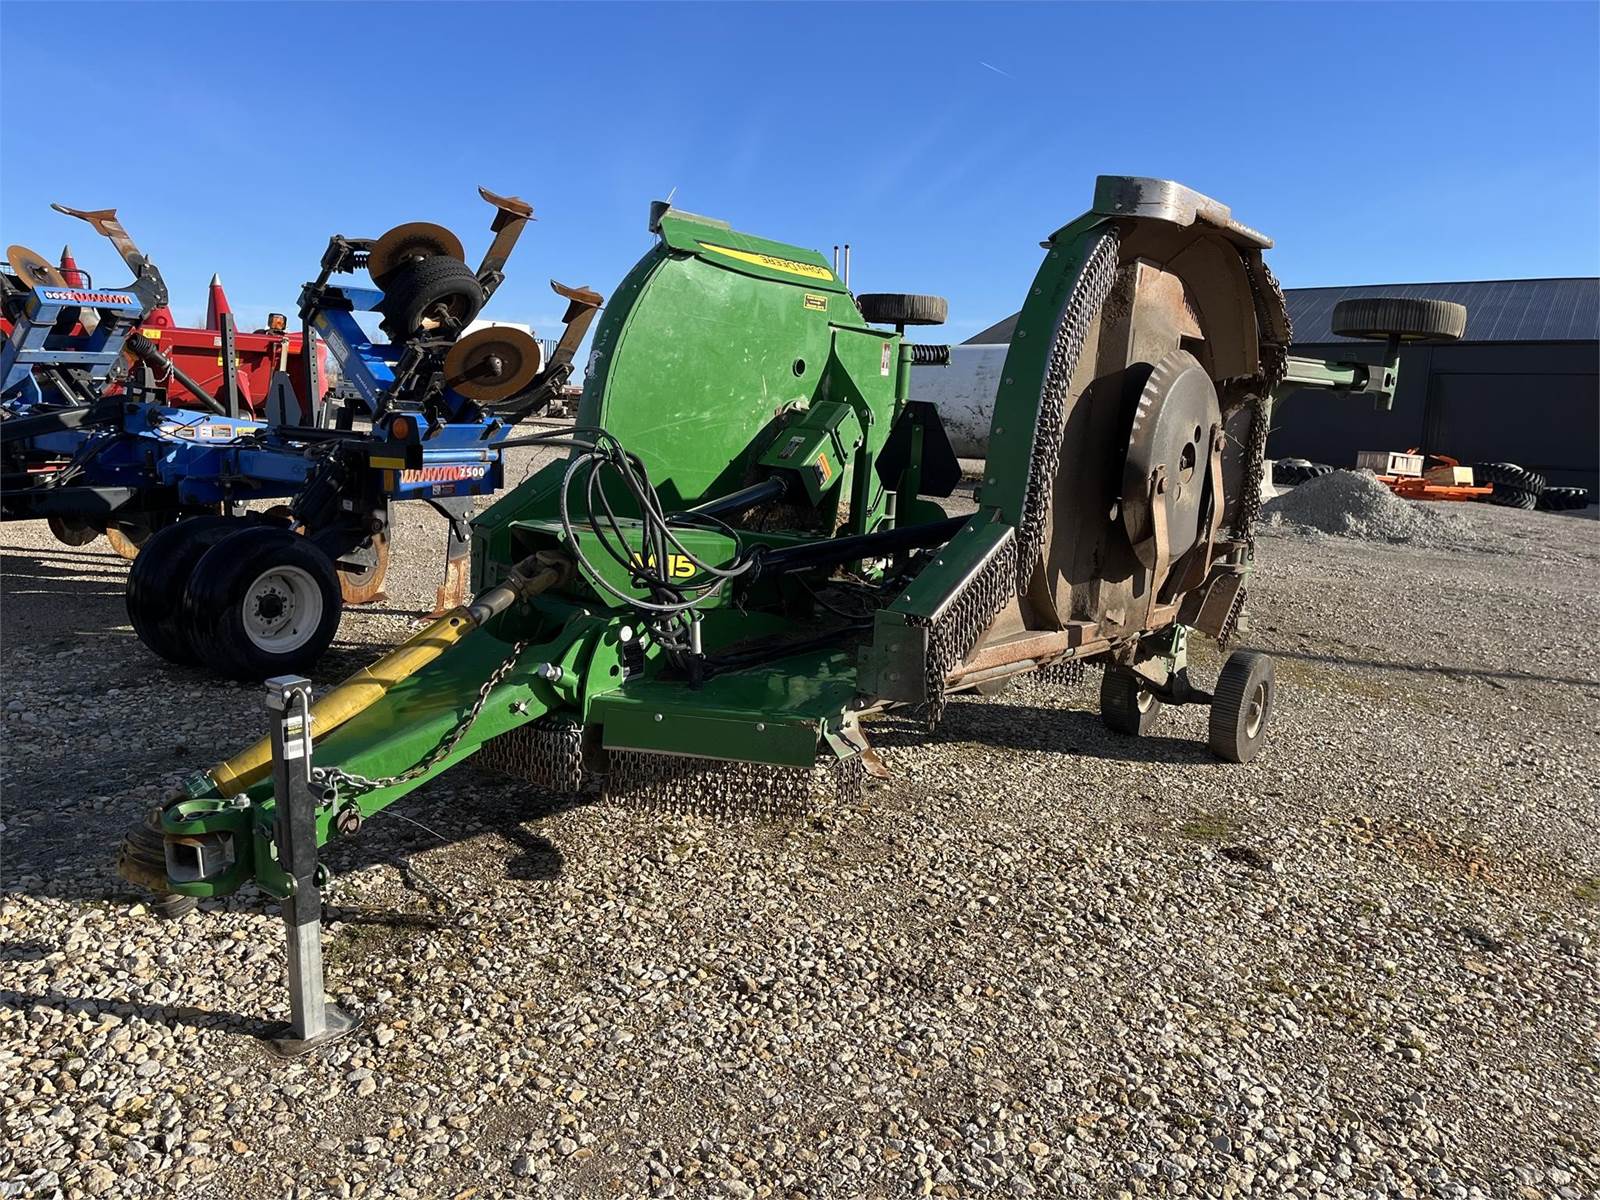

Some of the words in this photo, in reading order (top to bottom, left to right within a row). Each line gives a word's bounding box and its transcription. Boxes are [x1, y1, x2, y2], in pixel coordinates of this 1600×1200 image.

[760, 255, 797, 271] DEERE
[798, 263, 825, 277] JOHN
[460, 467, 485, 478] 2500
